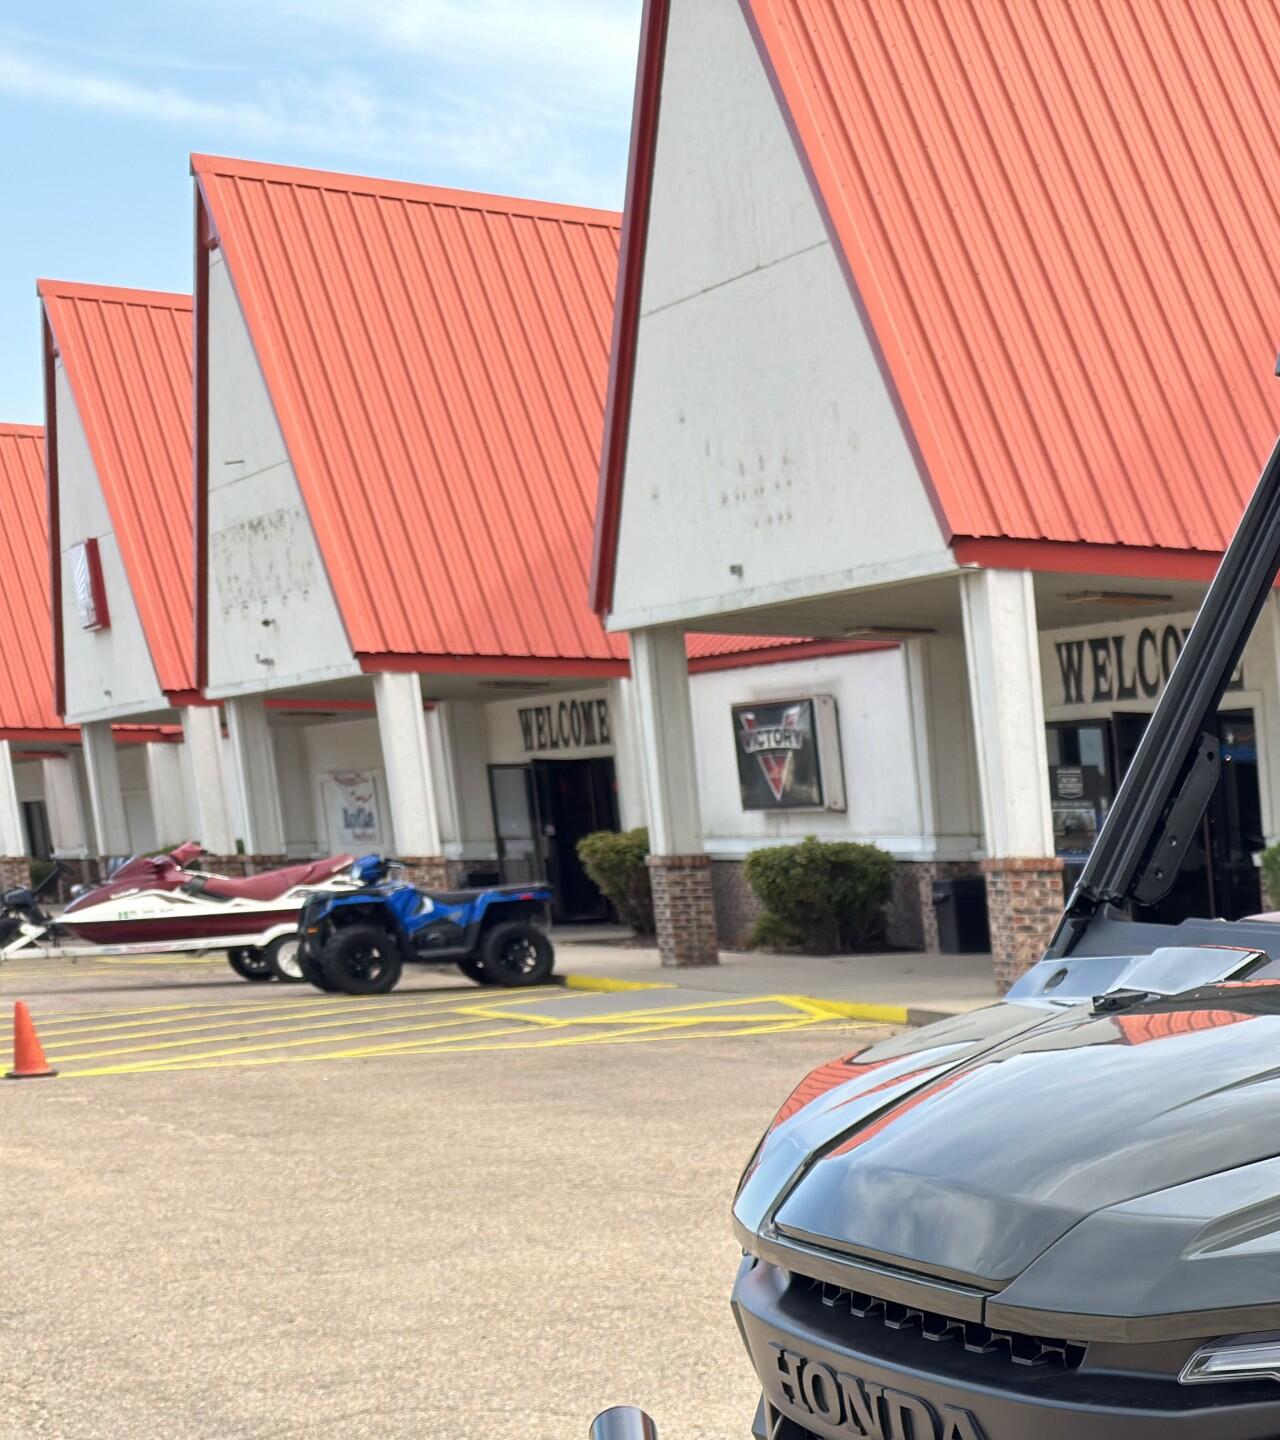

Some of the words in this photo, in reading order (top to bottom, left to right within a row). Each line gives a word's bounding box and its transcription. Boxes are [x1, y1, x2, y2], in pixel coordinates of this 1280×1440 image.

[1055, 624, 1245, 705] WELCO
[517, 699, 611, 751] WELCOME
[741, 728, 802, 749] VICTORY
